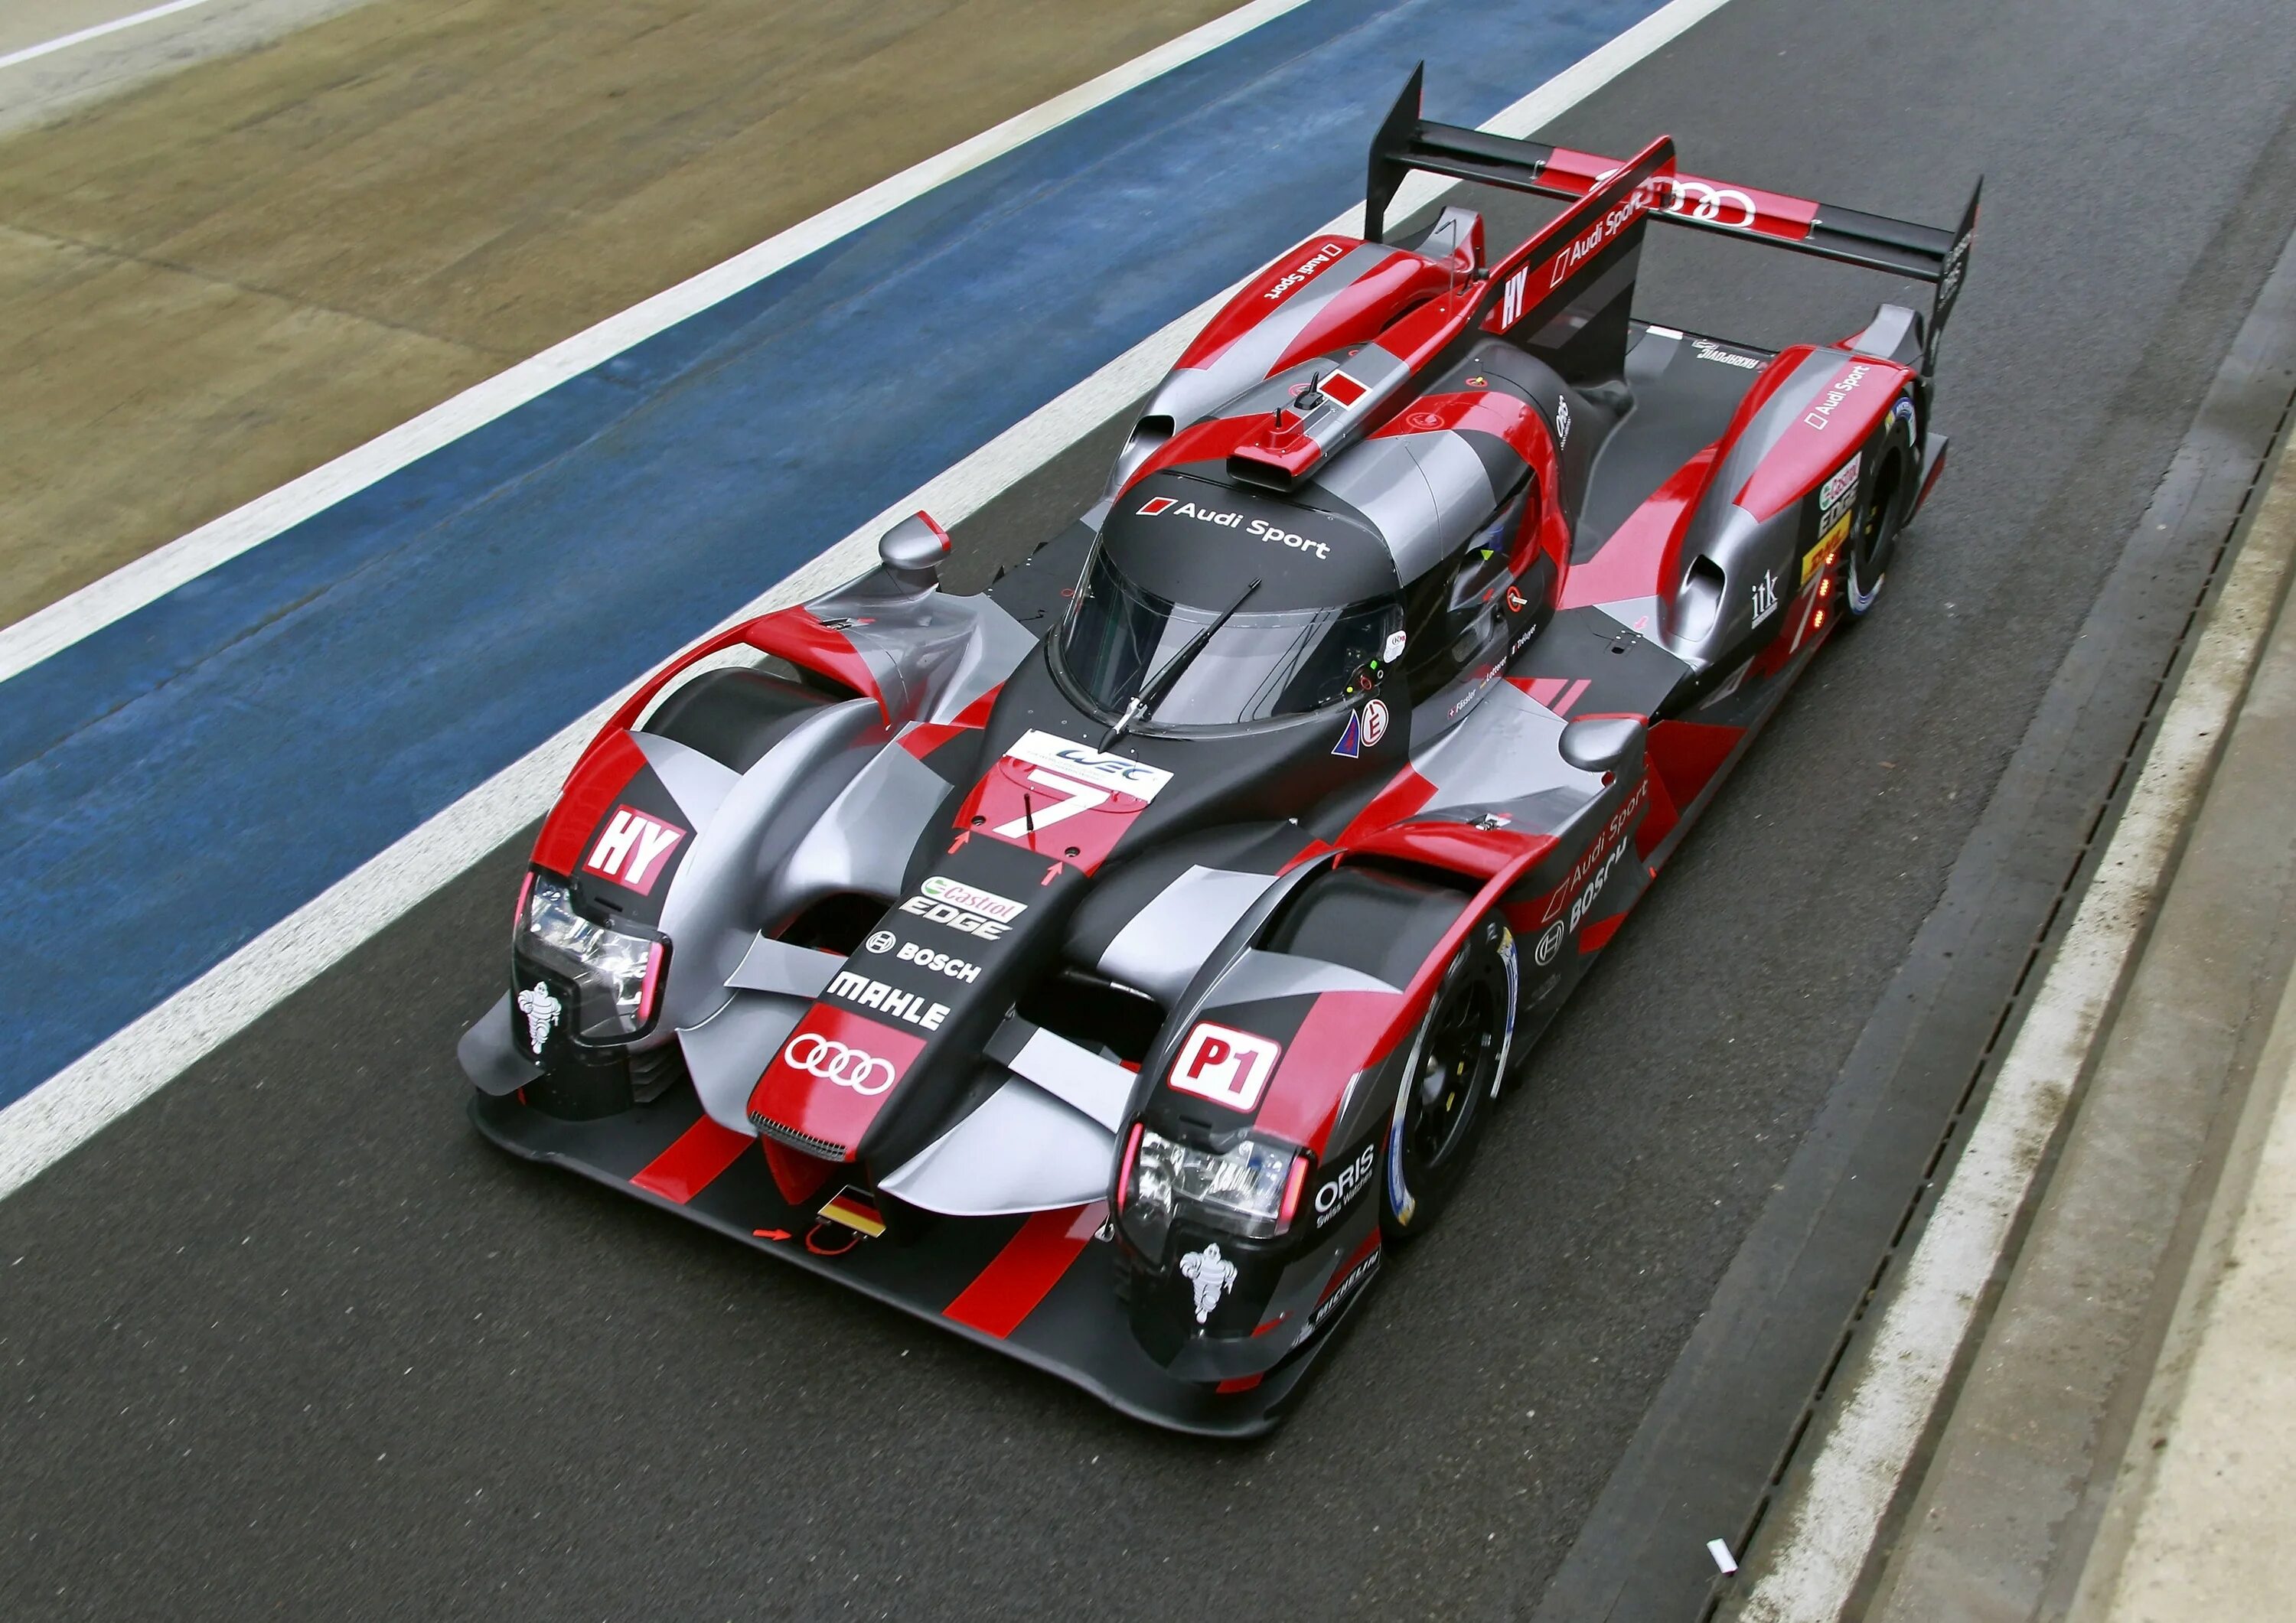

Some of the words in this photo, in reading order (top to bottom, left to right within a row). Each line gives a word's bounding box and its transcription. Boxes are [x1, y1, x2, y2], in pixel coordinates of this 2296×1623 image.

[1570, 220, 1603, 266] Audi
[1605, 191, 1642, 236] Sport
[1264, 273, 1306, 300] Sport
[1296, 253, 1330, 275] Audi
[1502, 265, 1529, 331] HY
[1815, 390, 1847, 416] Audi
[1835, 365, 1870, 392] Sport
[1173, 502, 1244, 528] Audi
[1245, 519, 1332, 560] Sport
[1750, 569, 1779, 621] itk
[1056, 749, 1154, 781] WEC
[992, 768, 1111, 839] 7
[587, 810, 680, 885] HY
[1570, 832, 1606, 892] Audi
[1609, 779, 1649, 842] Sport
[899, 895, 1013, 941] EDGE
[943, 886, 1016, 918] Castrol
[896, 941, 982, 984] BOSCH
[826, 970, 951, 1032] MAHLE
[1186, 1036, 1259, 1094] P1
[1315, 1143, 1375, 1213] ORIS
[1316, 1203, 1341, 1229] Swiss
[1315, 1249, 1378, 1322] MICHELIN
